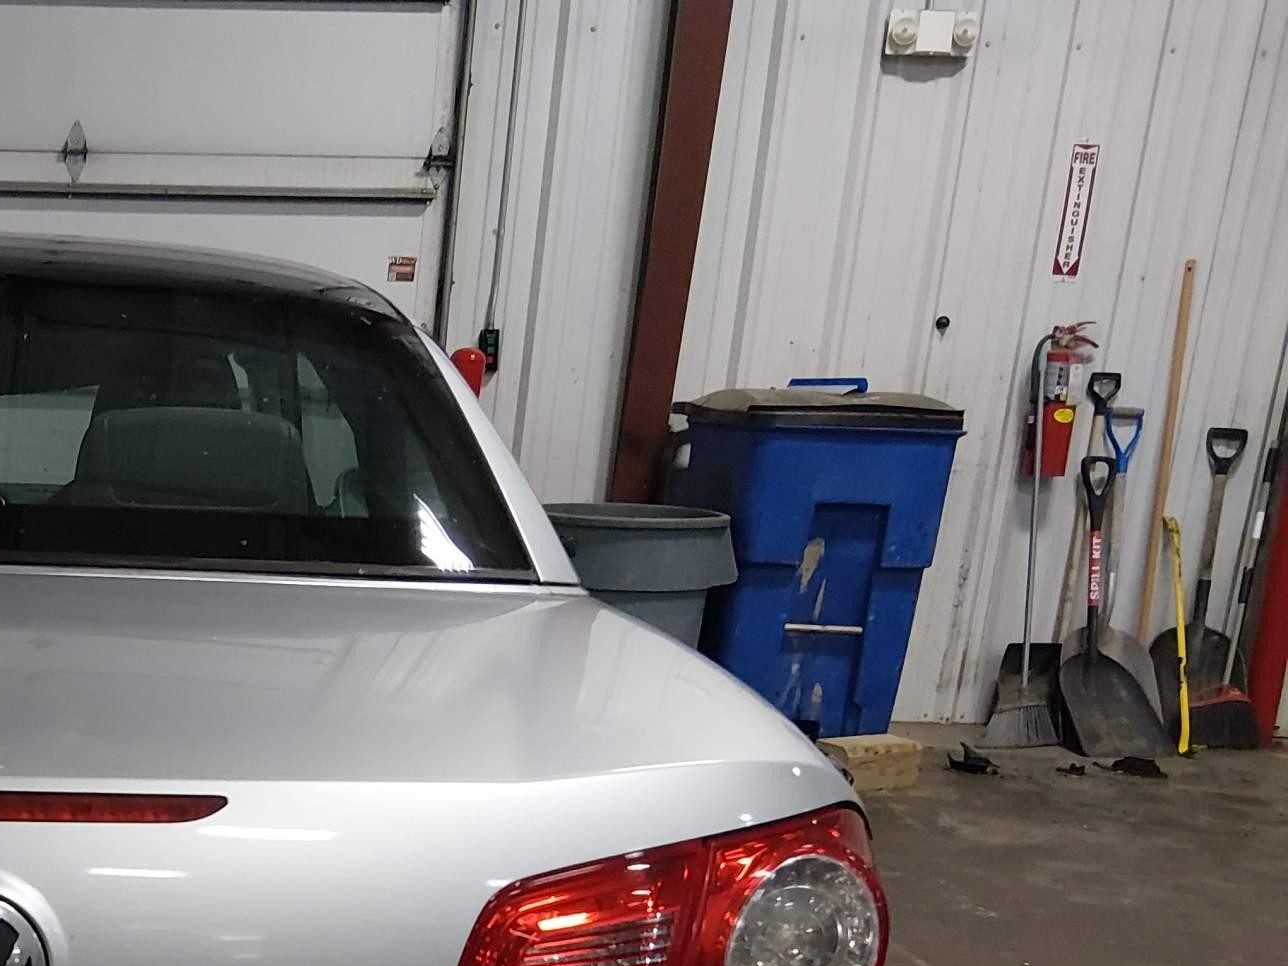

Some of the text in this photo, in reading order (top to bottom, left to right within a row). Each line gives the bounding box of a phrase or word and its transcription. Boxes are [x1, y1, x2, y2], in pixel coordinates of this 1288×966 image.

[1073, 152, 1096, 165] FIRE
[1063, 167, 1086, 268] EXTINGUISHER
[1090, 536, 1101, 599] SPILL KIT
